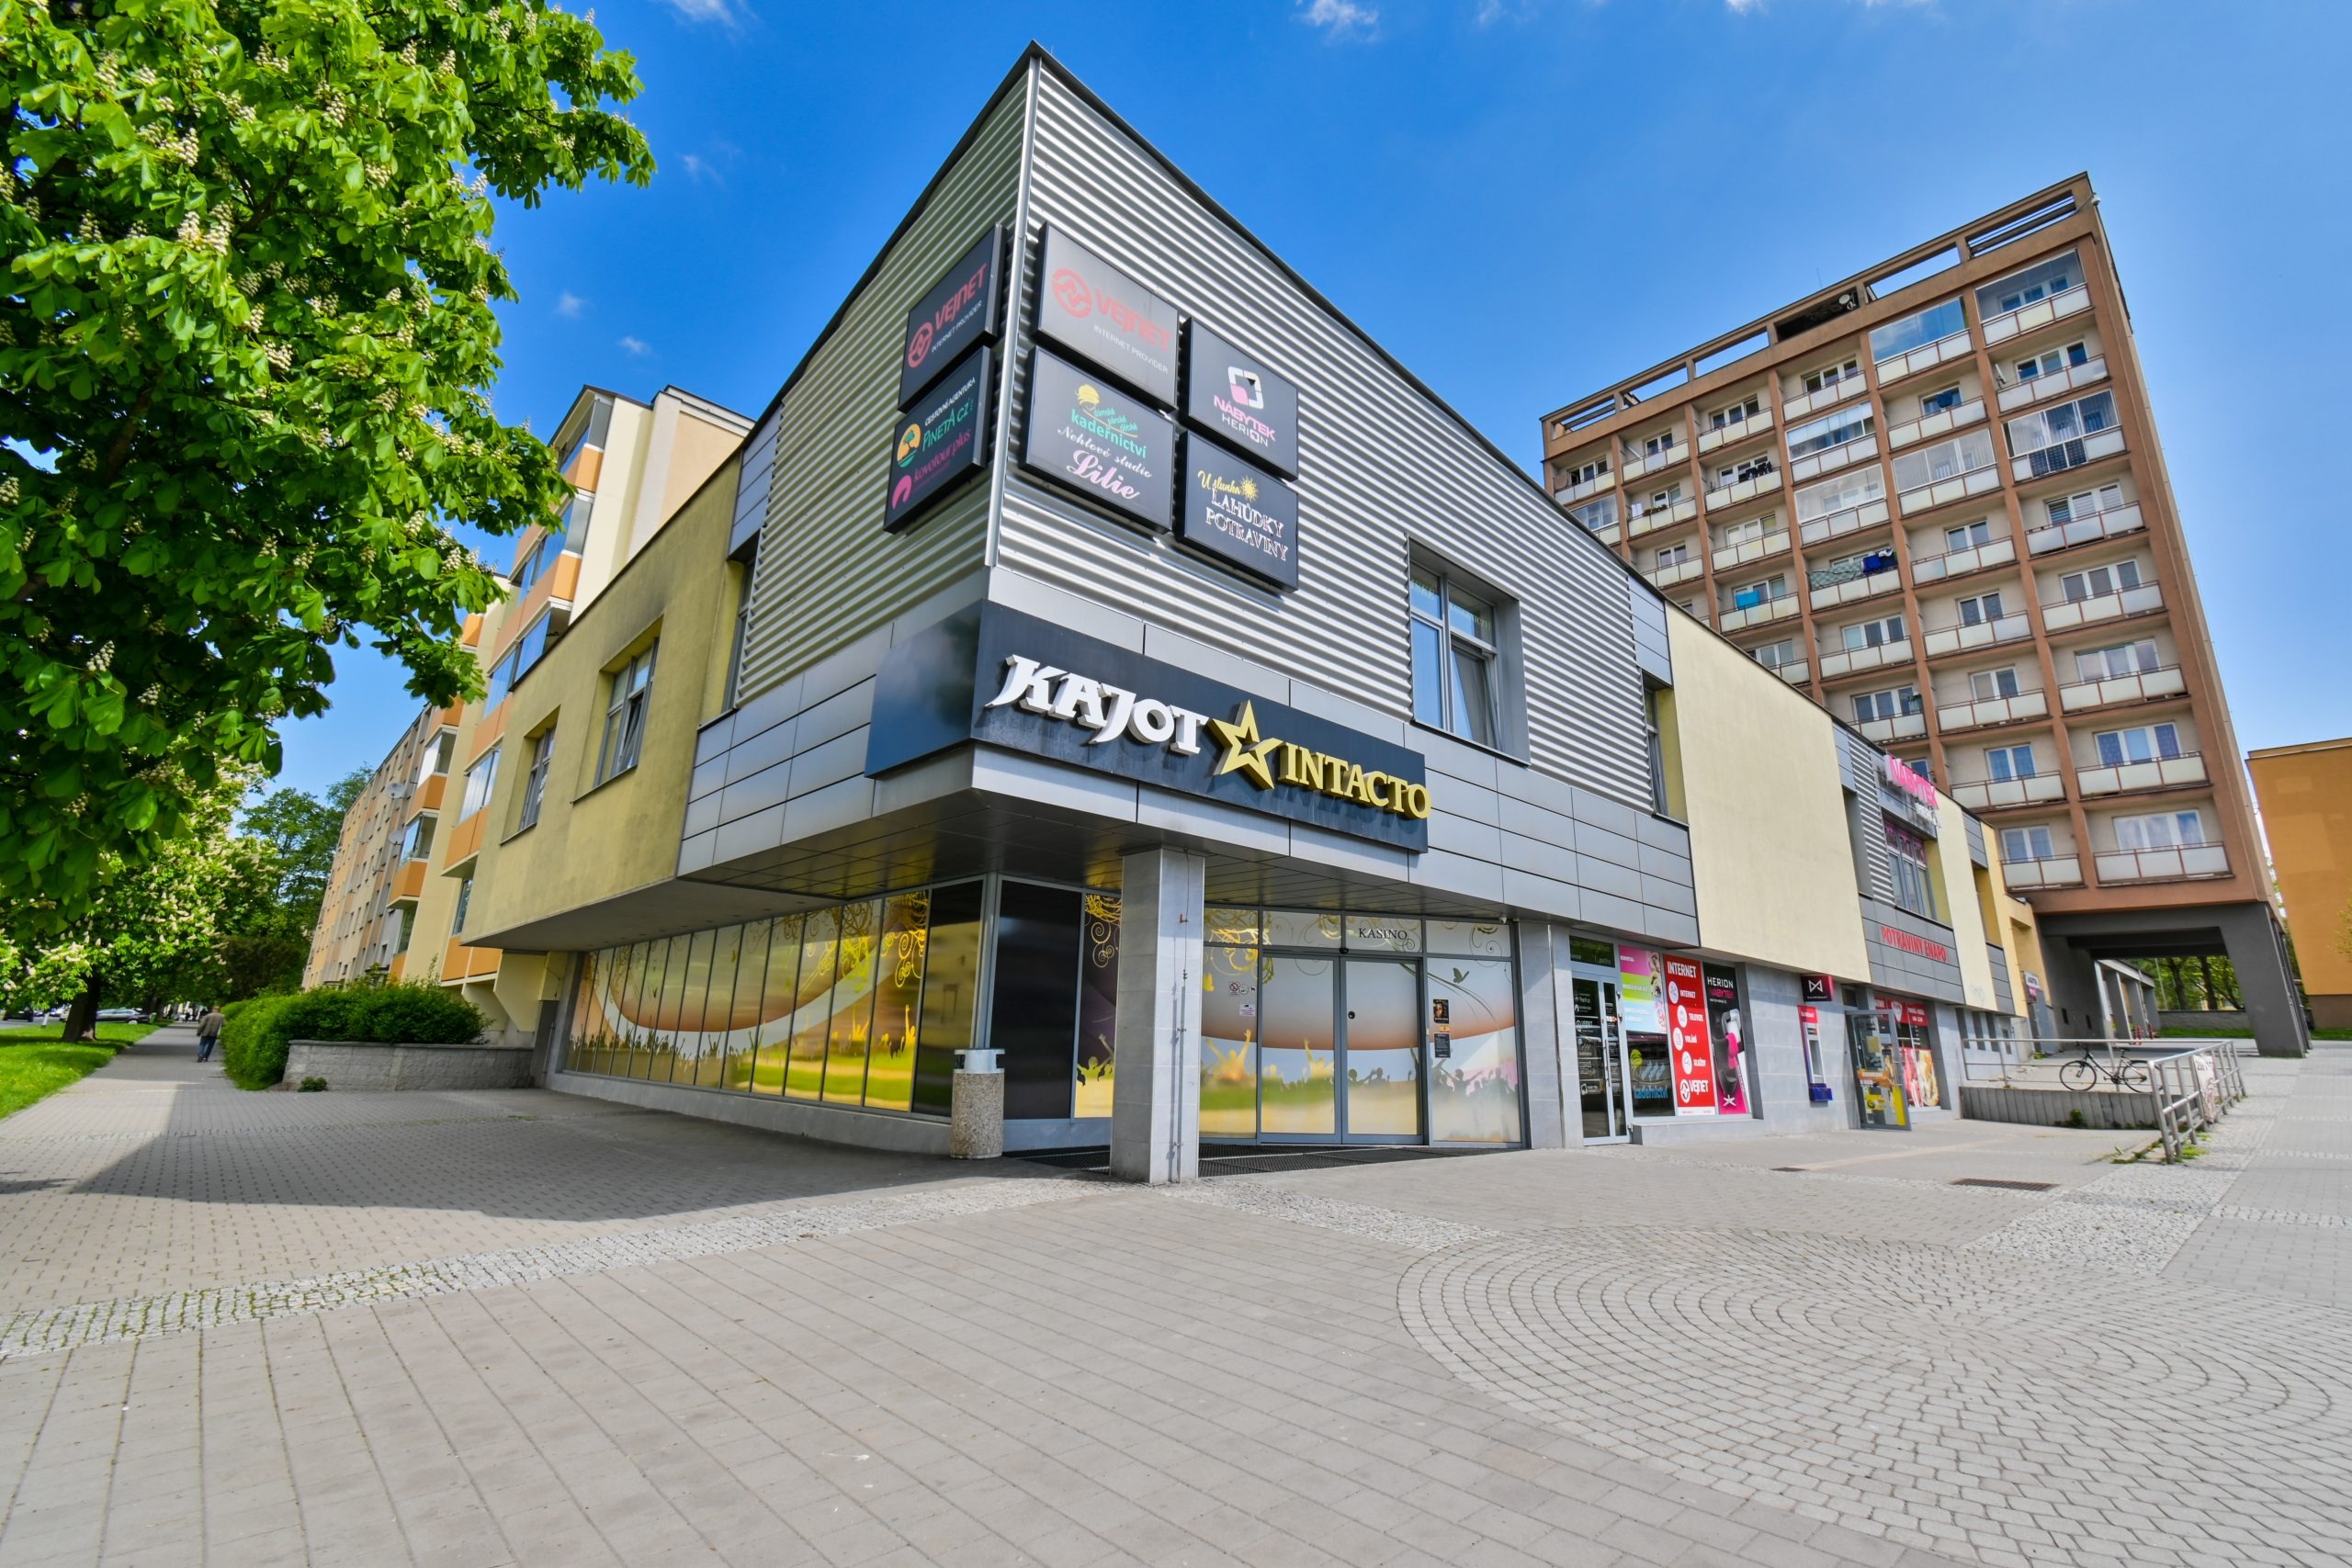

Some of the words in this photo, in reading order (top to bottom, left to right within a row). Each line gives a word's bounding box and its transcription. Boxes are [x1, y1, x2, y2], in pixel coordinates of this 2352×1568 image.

[931, 327, 956, 353] INTERNET
[956, 299, 983, 331] PROVIDER
[1093, 323, 1131, 352] INTERNET
[1131, 346, 1169, 375] PROVIDER
[948, 377, 976, 405] AGENTURA
[922, 408, 956, 452] PINETA
[1213, 394, 1276, 442] NÁBYTEK
[1221, 412, 1269, 447] HERION
[952, 429, 971, 457] plus
[1066, 449, 1141, 500] Lilie
[1114, 456, 1153, 478] studio
[1197, 469, 1212, 491] U
[1211, 489, 1284, 539] LAHŮDKY
[1204, 506, 1288, 562] POTRAVINY
[984, 653, 1210, 757] KAJOT
[1278, 741, 1432, 819] INTACTO
[1358, 928, 1408, 941] KASINO
[1881, 925, 1924, 955] POTRAVINY
[1667, 961, 1697, 978] INTERNET
[1707, 976, 1734, 989] HERION
